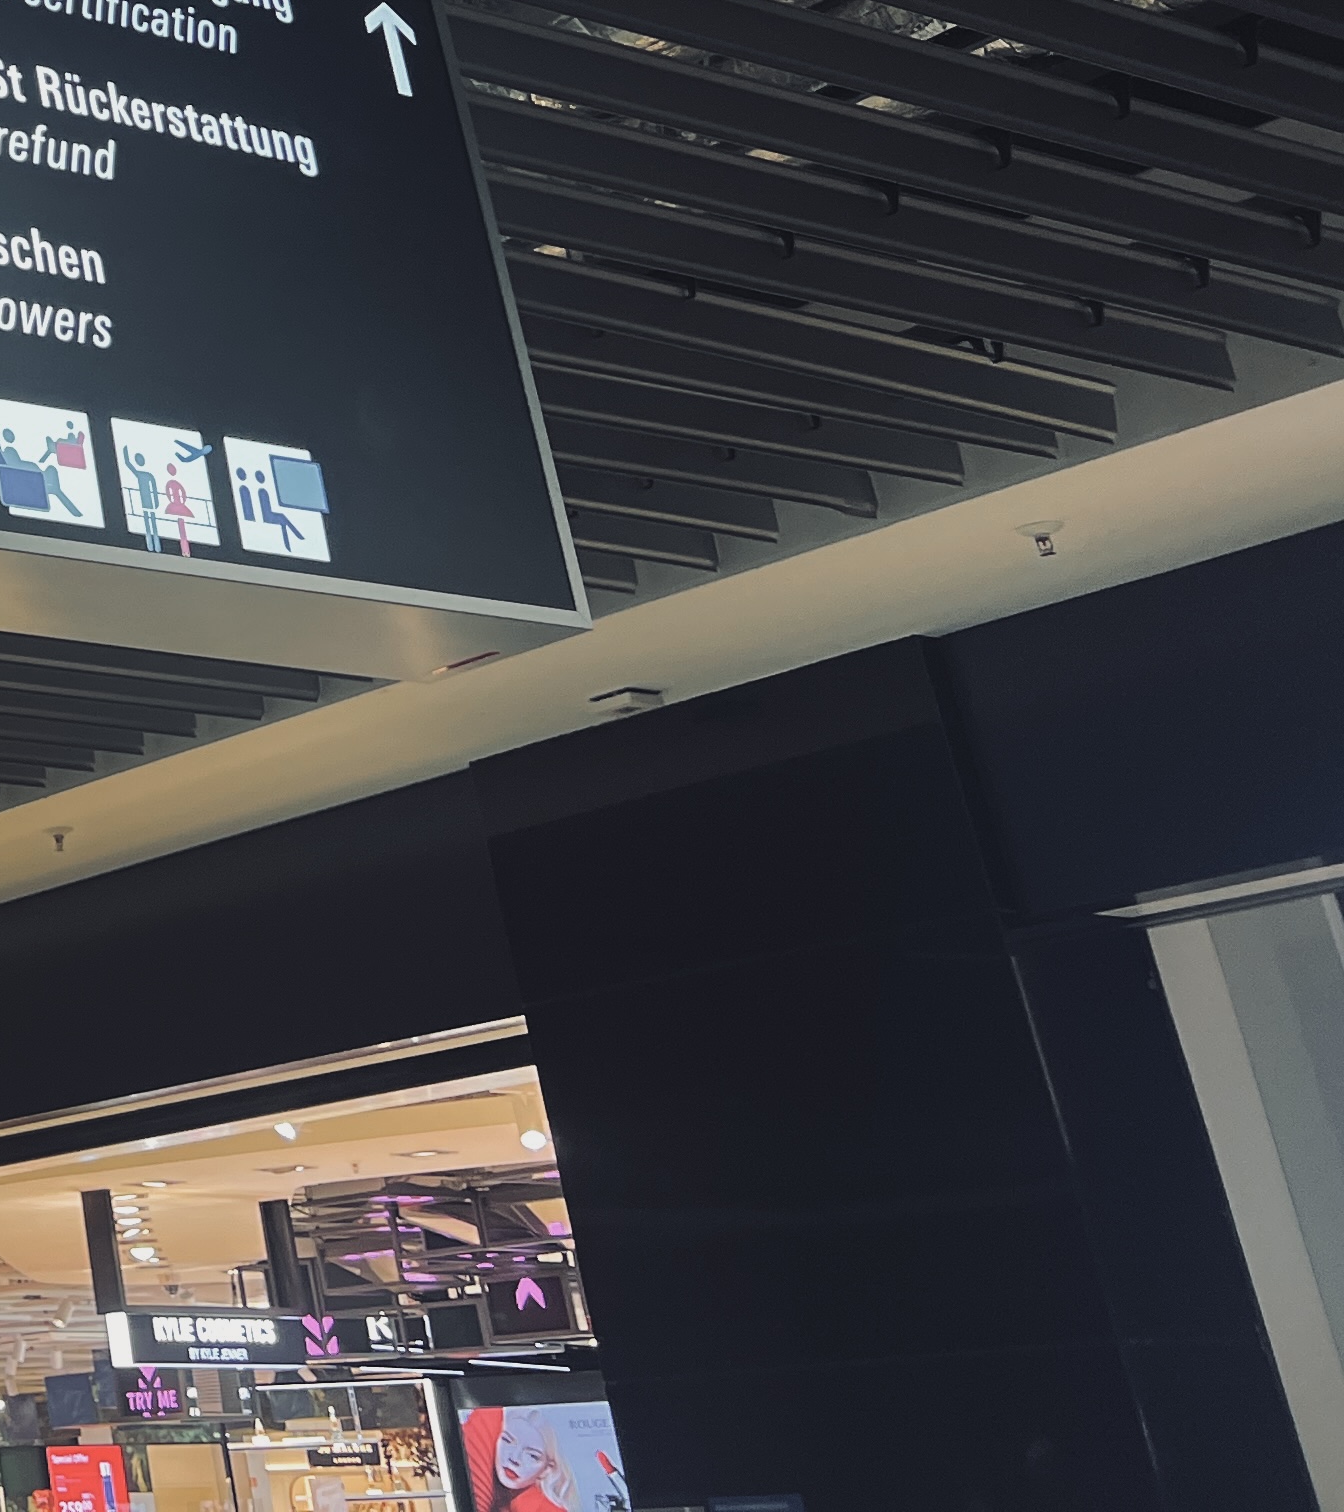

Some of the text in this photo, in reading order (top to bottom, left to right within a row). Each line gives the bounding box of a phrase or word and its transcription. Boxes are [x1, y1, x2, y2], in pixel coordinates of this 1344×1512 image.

[37, 64, 319, 177] Rückerstattung
[126, 1389, 179, 1412] TRY ME
